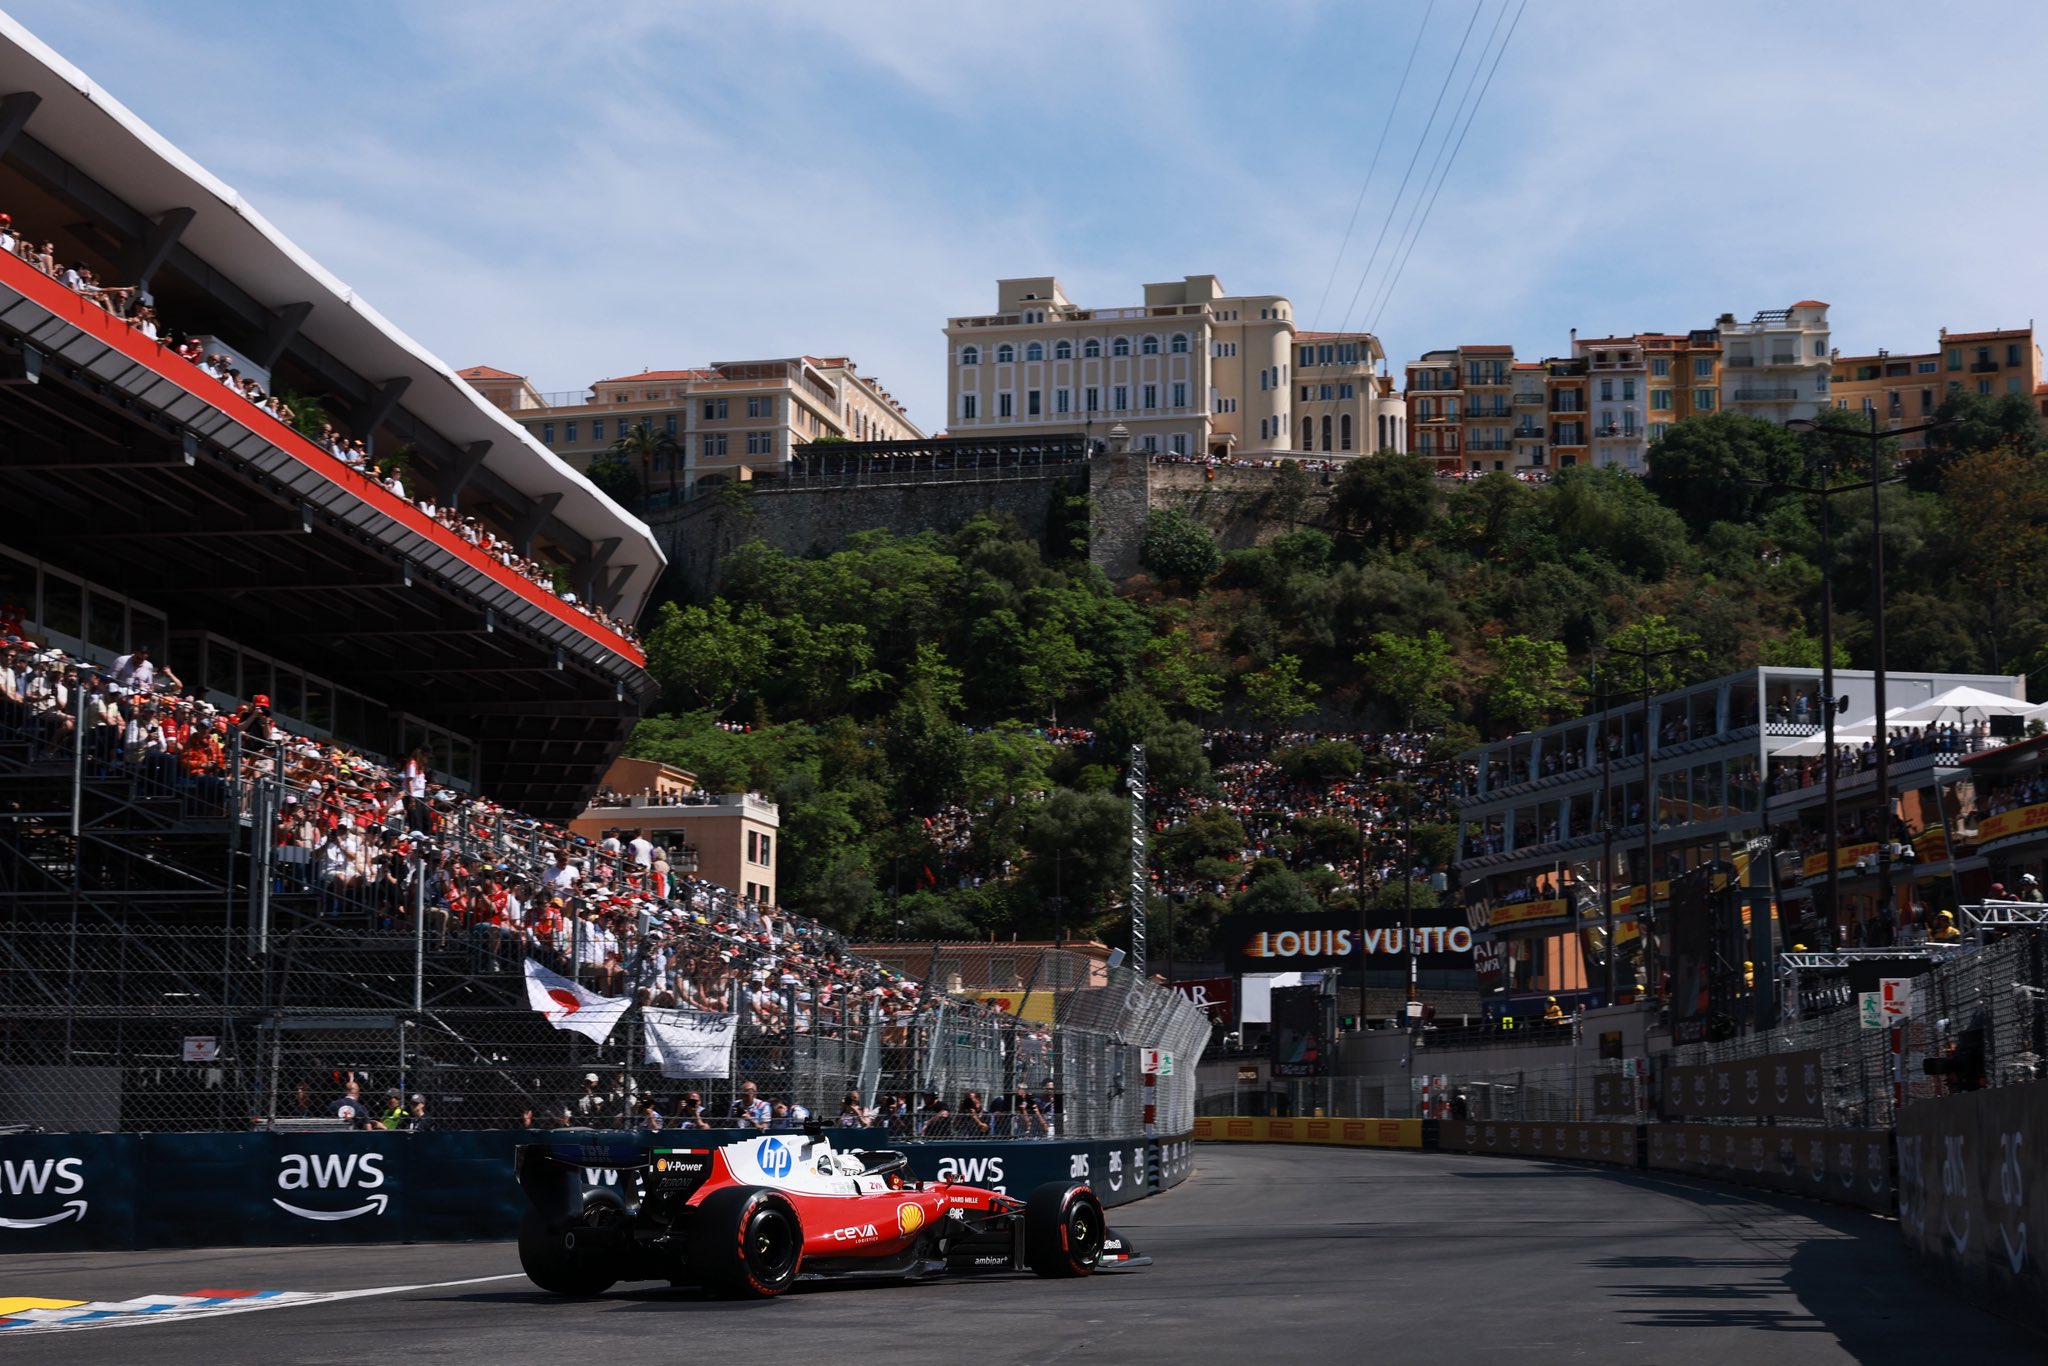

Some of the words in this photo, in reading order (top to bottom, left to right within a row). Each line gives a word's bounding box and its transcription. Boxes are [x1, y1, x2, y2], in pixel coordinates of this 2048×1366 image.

[1261, 930, 1352, 957] LOUIS
[277, 1152, 384, 1190] aws
[666, 1161, 703, 1172] V-Power
[762, 1143, 788, 1178] hp
[937, 1157, 1003, 1183] aws
[0, 1156, 84, 1194] ws
[974, 1256, 1004, 1265] ambipar
